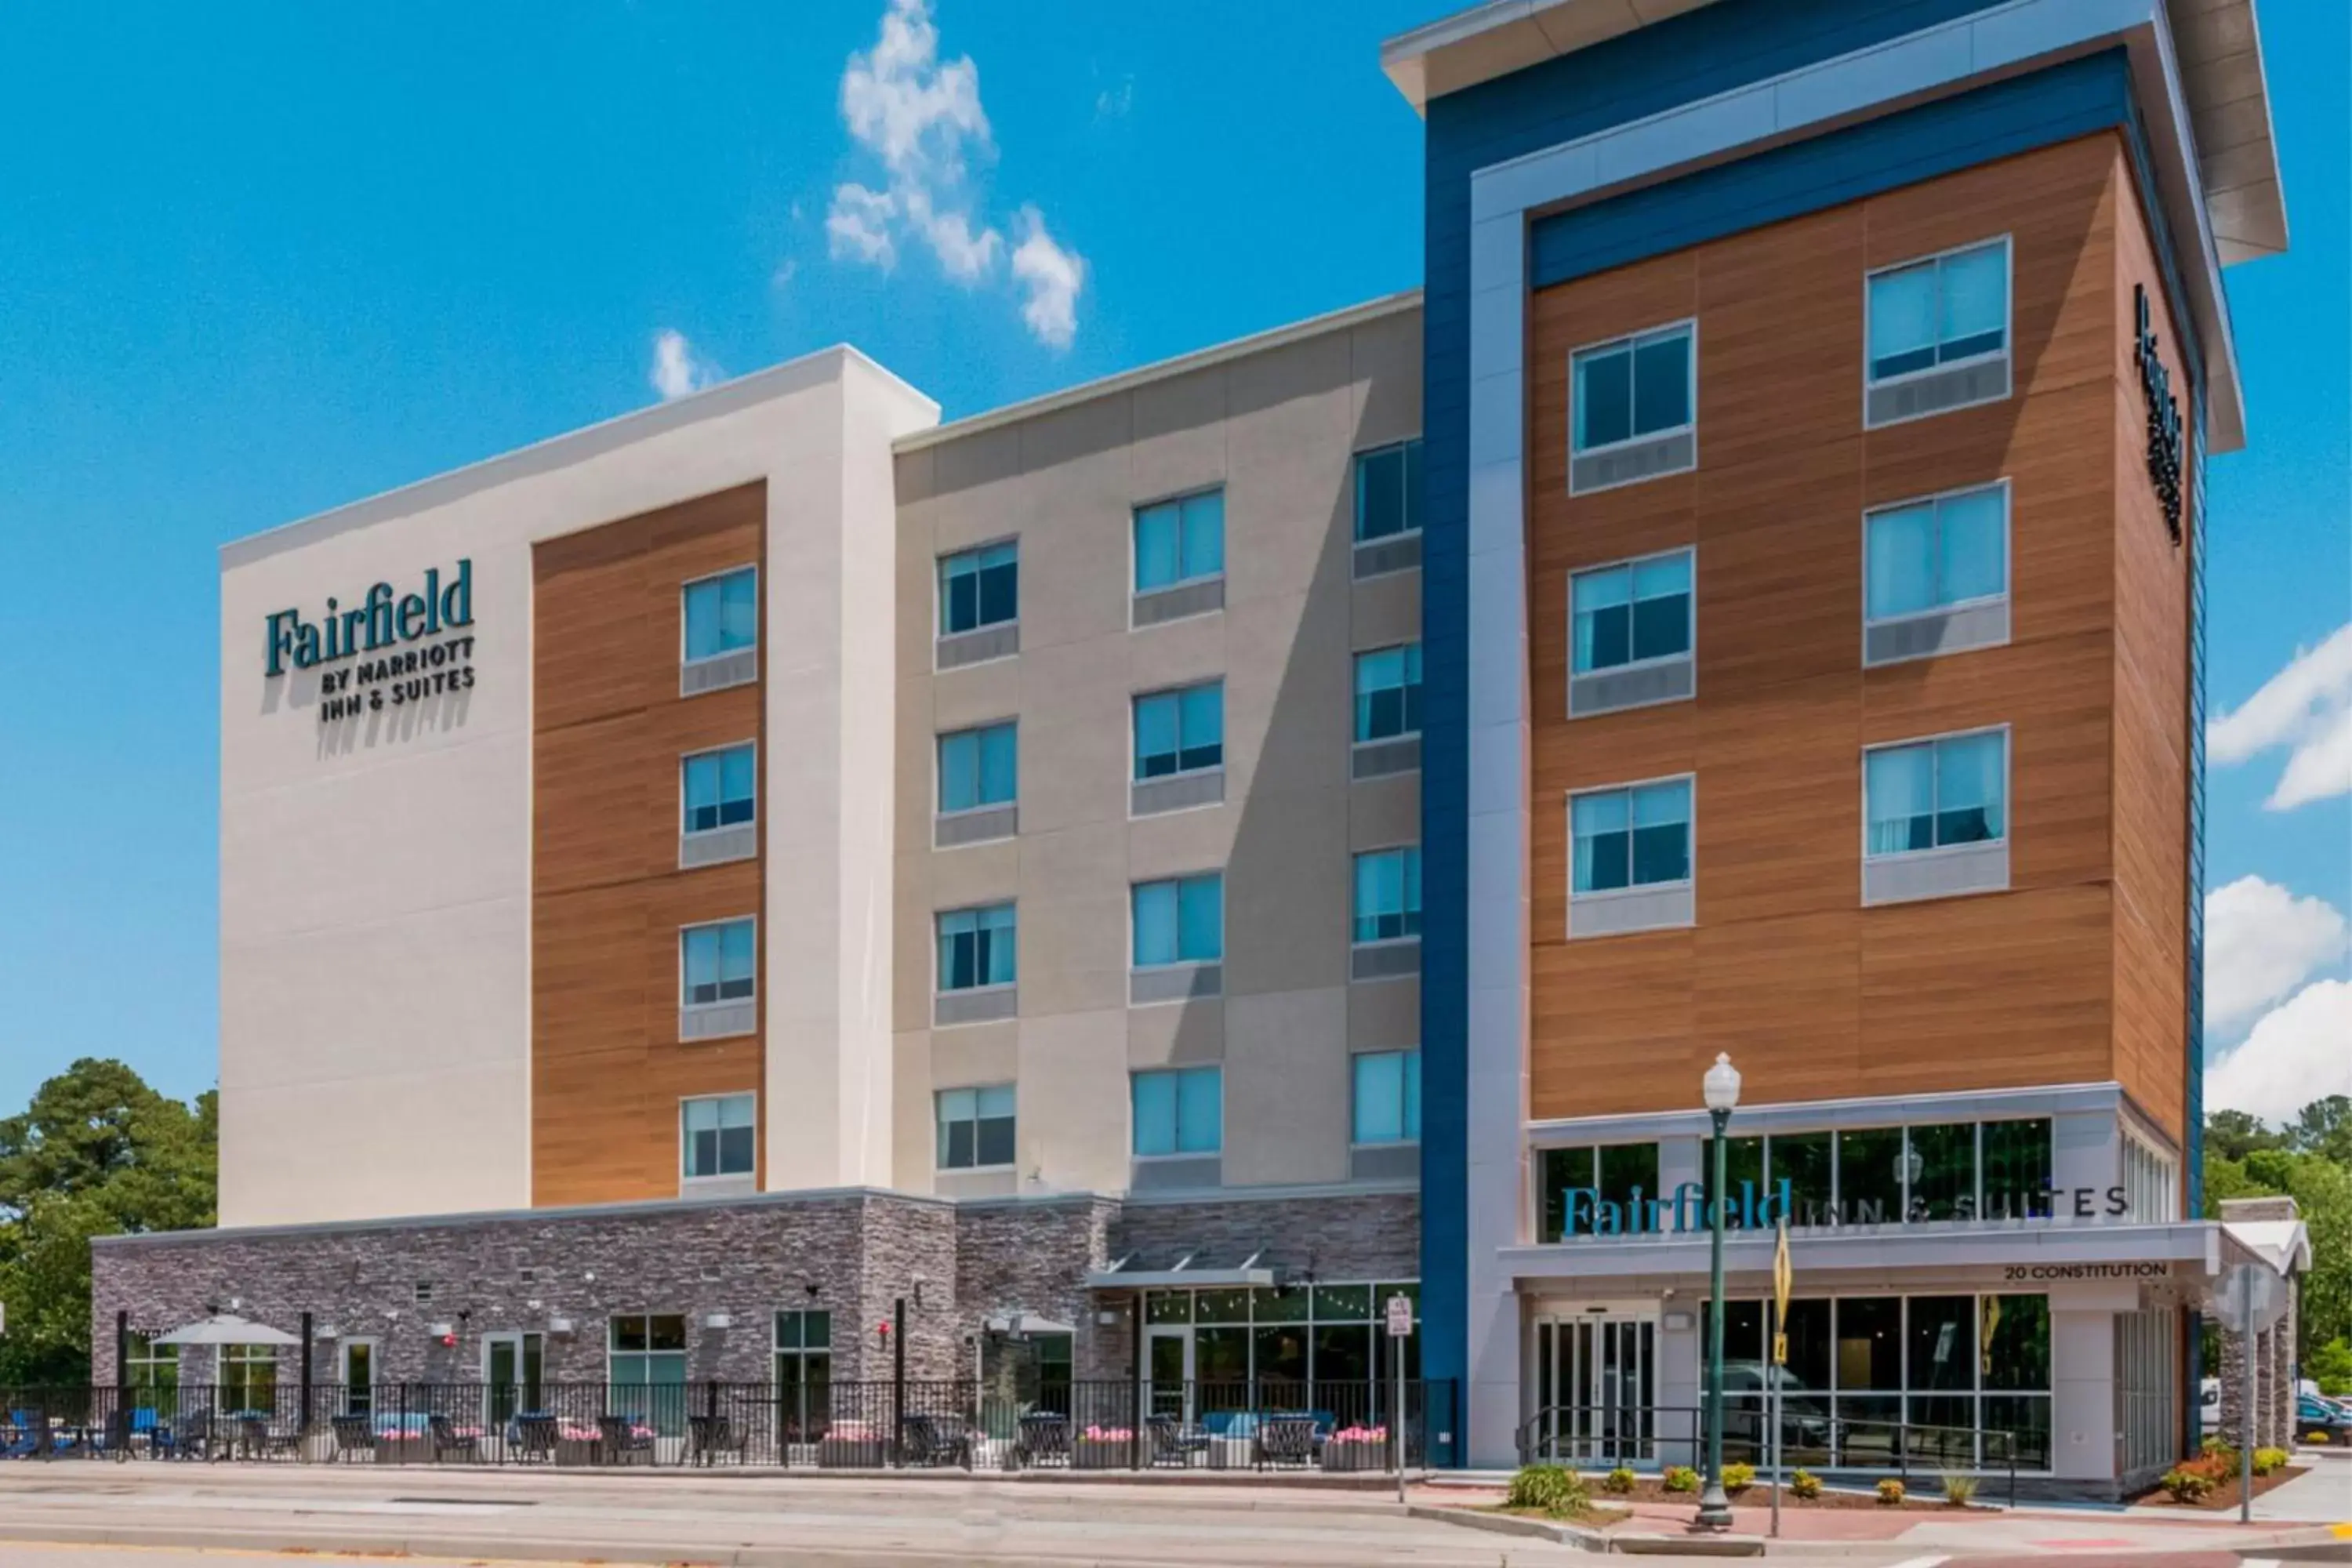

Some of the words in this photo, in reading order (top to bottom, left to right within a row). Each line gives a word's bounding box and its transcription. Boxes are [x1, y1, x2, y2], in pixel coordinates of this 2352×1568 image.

[265, 557, 474, 677] Fairfield
[321, 667, 350, 695] BY
[358, 637, 474, 685] MARRIOTT
[321, 693, 361, 722] INN
[368, 688, 383, 711] &
[391, 666, 474, 705] SUITES
[1561, 1178, 1791, 1236] Fairfield
[1806, 1199, 1883, 1225] INN
[1907, 1196, 1931, 1223] &
[1951, 1186, 2129, 1221] SUITES
[2005, 1265, 2027, 1279] 20
[2031, 1262, 2167, 1279] CONSTITUTION
